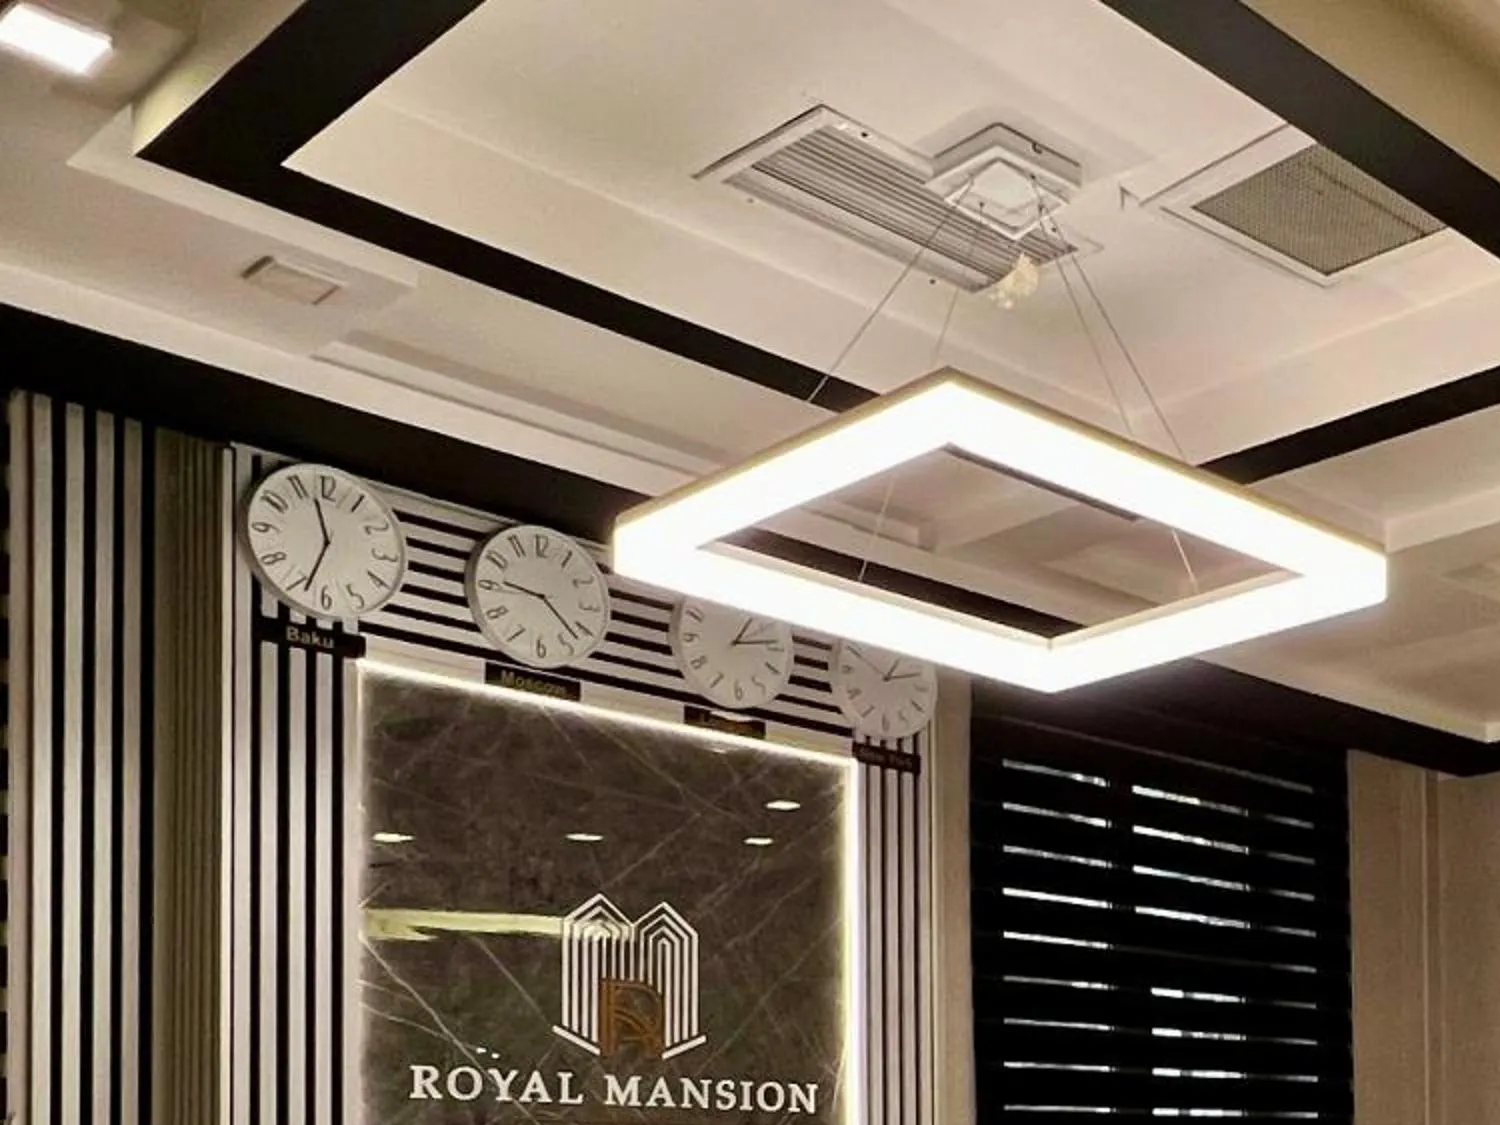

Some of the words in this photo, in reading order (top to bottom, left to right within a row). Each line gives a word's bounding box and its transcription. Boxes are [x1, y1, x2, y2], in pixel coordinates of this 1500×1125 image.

[286, 625, 335, 649] Baku
[409, 1064, 584, 1105] ROYAL
[604, 1074, 818, 1114] MANSION
